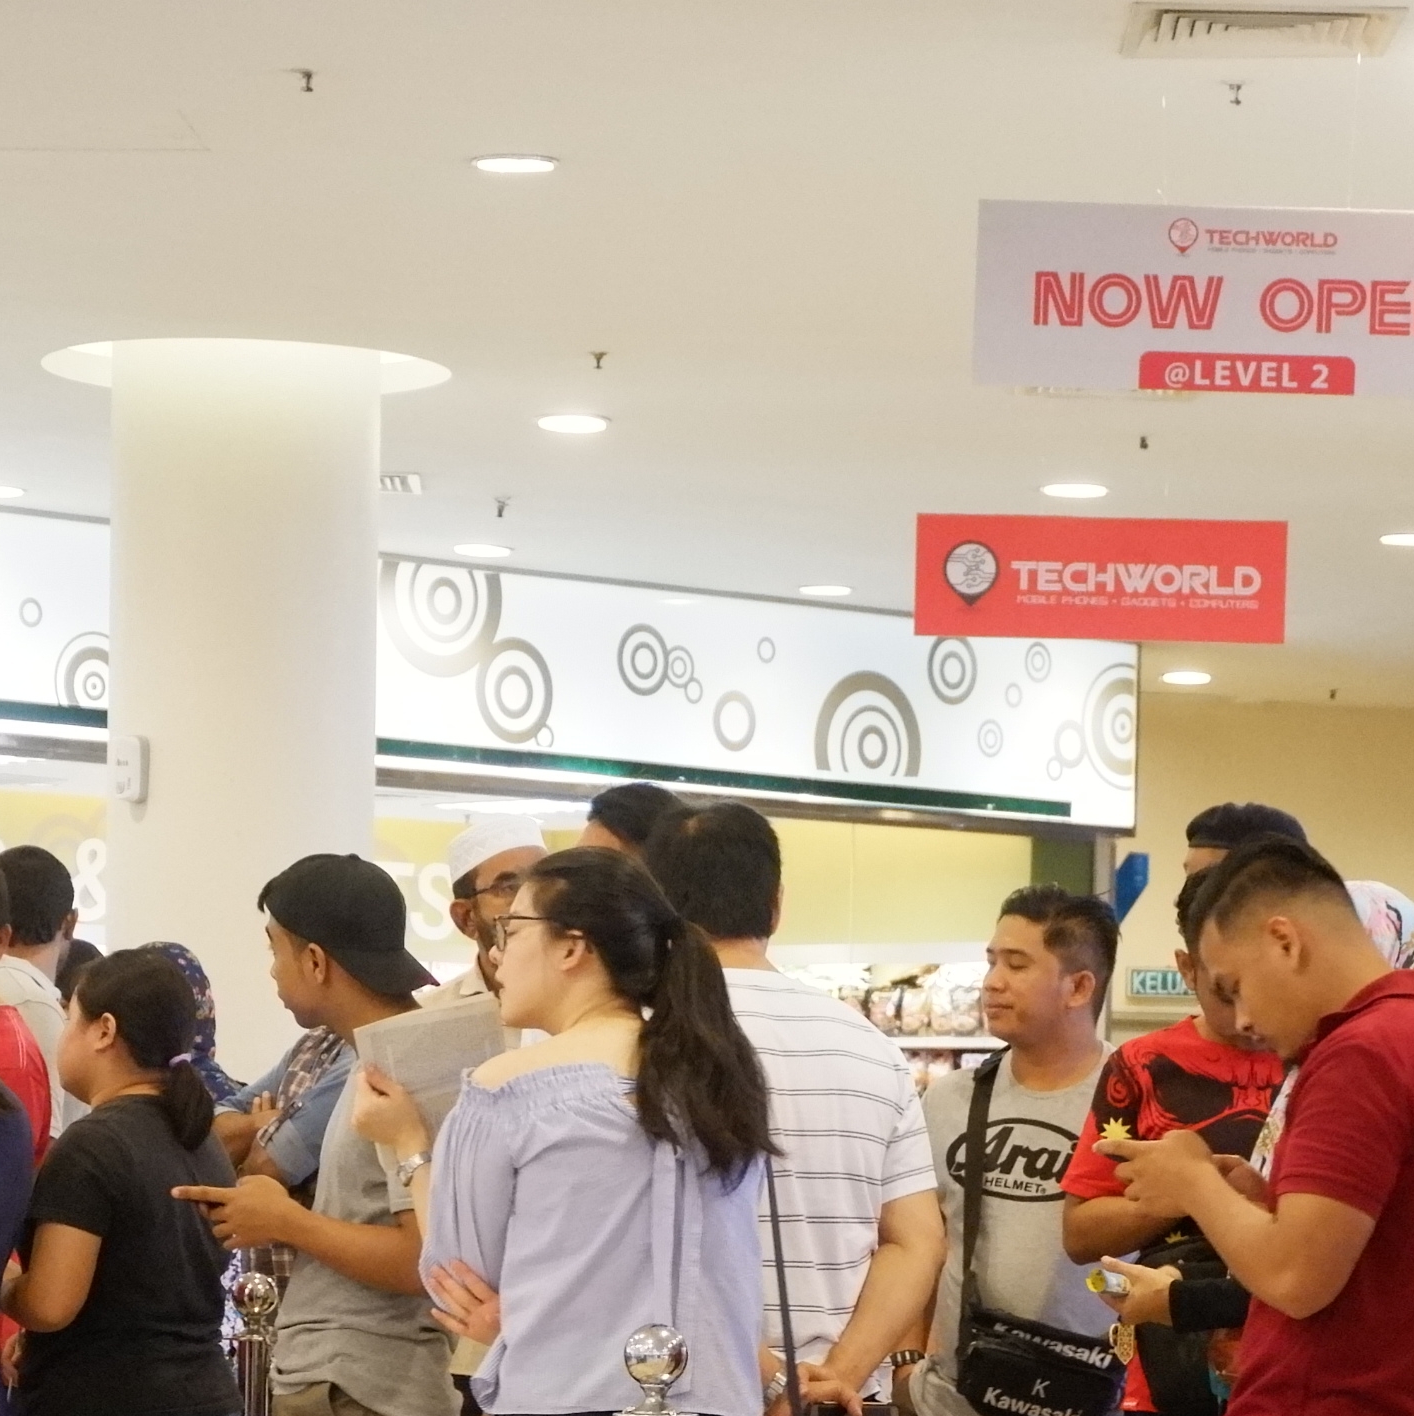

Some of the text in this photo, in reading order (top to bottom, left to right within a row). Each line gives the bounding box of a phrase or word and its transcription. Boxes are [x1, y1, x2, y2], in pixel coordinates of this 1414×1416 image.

[1205, 229, 1338, 248] TECHWORLD
[1033, 271, 1224, 330] NOW
[1164, 359, 1330, 389] @LEVEL 2
[1011, 561, 1262, 596] TECHWORLD
[1016, 594, 1260, 610] MOBILE PHONES GADGETS COMPUTERS
[1132, 971, 1196, 994] KELU
